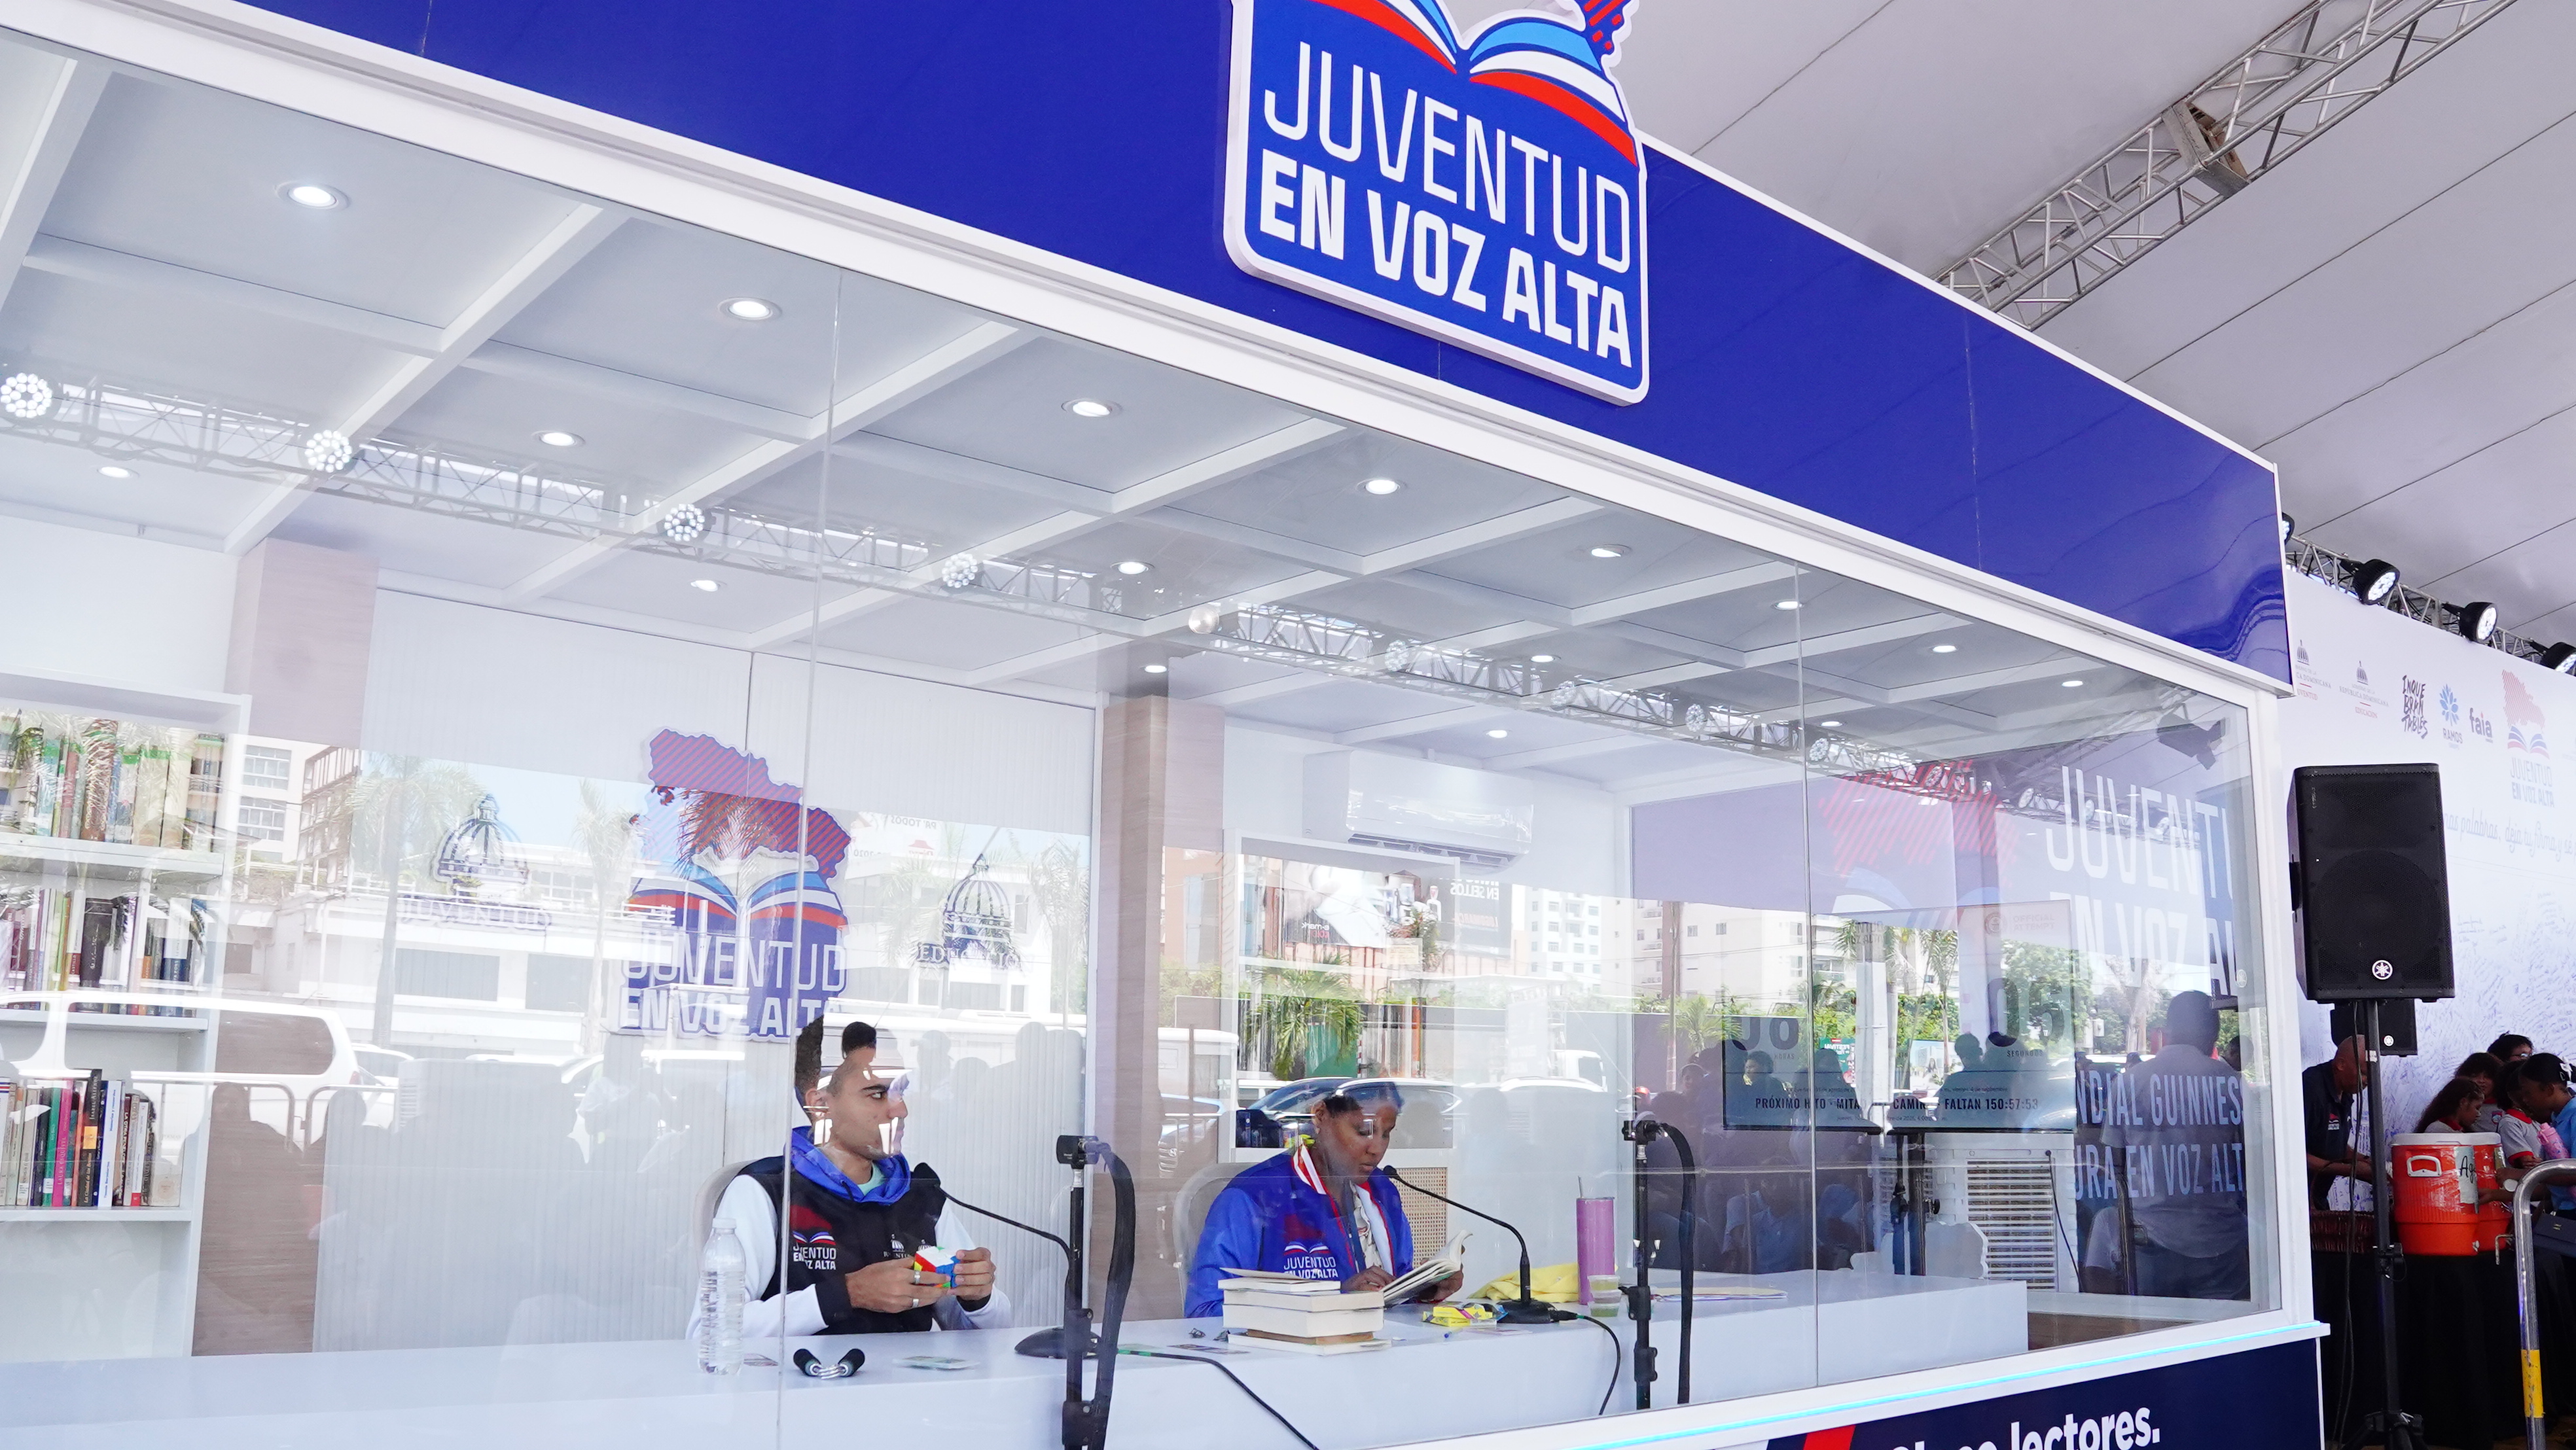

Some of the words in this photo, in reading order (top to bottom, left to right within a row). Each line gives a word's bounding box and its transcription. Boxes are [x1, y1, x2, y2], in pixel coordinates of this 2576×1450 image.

[1264, 41, 1630, 274] JUVENTUD
[1259, 148, 1346, 260] EN
[1367, 188, 1486, 313] VOZ
[1502, 247, 1632, 368] ALTA
[2339, 685, 2363, 698] REPÚBLICA
[2363, 694, 2389, 707] DOMINICANA
[2402, 675, 2426, 699] INQUE
[2404, 694, 2424, 718] BRAN
[2401, 715, 2429, 739] TABLES
[2469, 707, 2493, 738] faia
[2442, 728, 2463, 743] RAMOS
[2510, 757, 2553, 788] JUVENTUD
[2512, 781, 2522, 800] EN
[2522, 784, 2537, 804] VOZ
[2538, 788, 2555, 808] ALTA
[2013, 913, 2055, 922] OFFICIAL
[2014, 922, 2054, 931] ATTEMPT
[2115, 902, 2187, 989] VOZ
[622, 929, 846, 992] JUVENTUD
[620, 987, 668, 1029] EN
[678, 992, 750, 1034] VOZ
[1755, 1095, 1800, 1110] PRÓXIMO
[1804, 1099, 1826, 1110] HTO
[1945, 1099, 1980, 1110] FALTAN
[1986, 1099, 2038, 1110] 150:57:53
[2150, 1074, 2245, 1127] GUINNES
[2126, 1145, 2155, 1198] EN
[2162, 1144, 2204, 1196] VOZ
[2460, 1156, 2476, 1184] Ag
[815, 1260, 836, 1270] ALTA
[1283, 1256, 1336, 1270] JUVENTUD
[1317, 1268, 1338, 1279] ALTA
